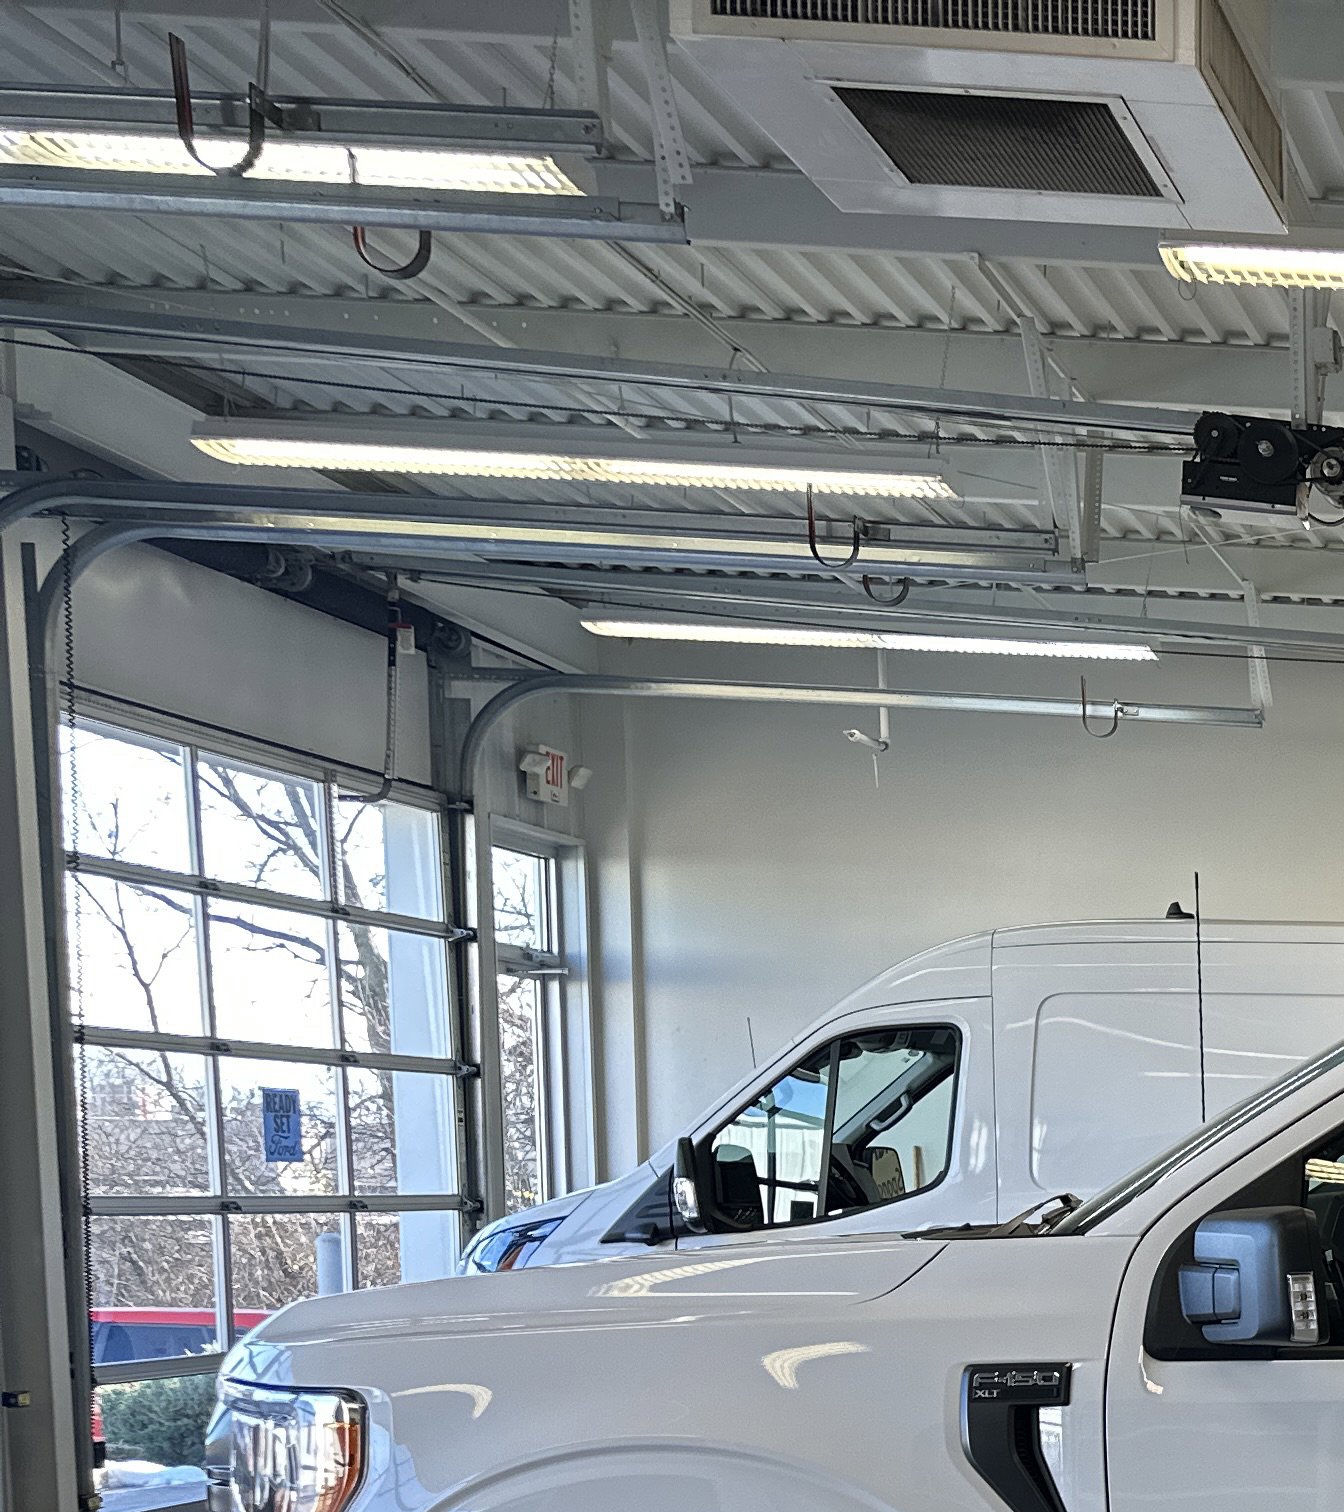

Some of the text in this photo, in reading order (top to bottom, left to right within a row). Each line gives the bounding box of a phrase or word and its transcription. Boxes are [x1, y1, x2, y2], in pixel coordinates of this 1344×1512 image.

[545, 750, 565, 790] EXIT
[264, 1093, 297, 1114] READY
[273, 1114, 291, 1134] SET
[268, 1133, 299, 1157] Ford
[972, 1370, 1061, 1388] F-150
[974, 1388, 1000, 1399] XLT
